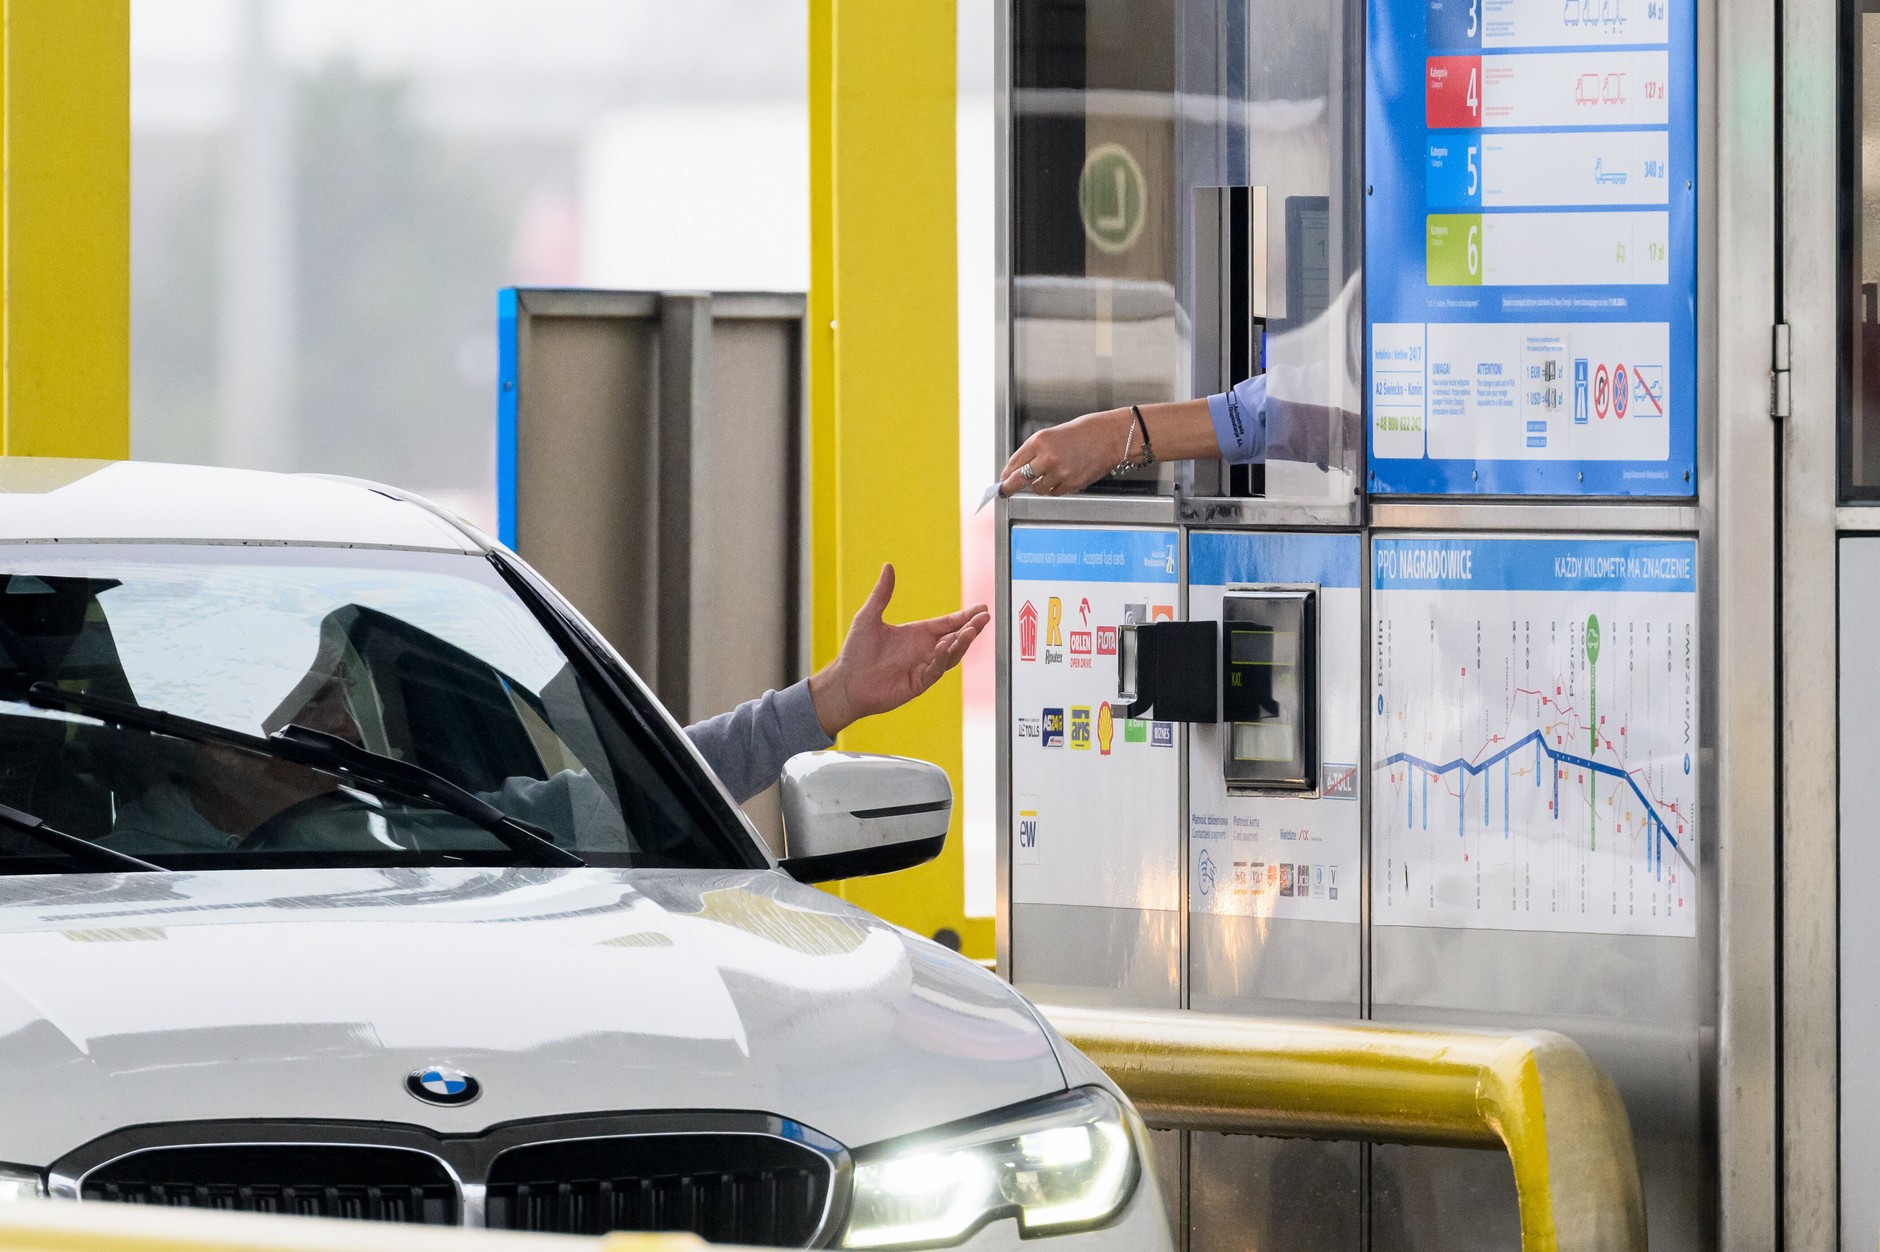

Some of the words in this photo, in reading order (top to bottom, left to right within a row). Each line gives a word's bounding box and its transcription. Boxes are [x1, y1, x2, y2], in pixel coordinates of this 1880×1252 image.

[1467, 0, 1478, 37] 3
[1648, 2, 1657, 19] 84
[1466, 67, 1478, 116] 4
[1644, 81, 1656, 99] 127
[1467, 146, 1478, 196] 5
[1644, 160, 1657, 178] 340
[1467, 225, 1478, 275] 6
[1649, 243, 1657, 260] 17
[1530, 366, 1541, 378] EUR
[1375, 382, 1383, 395] A2
[1383, 378, 1404, 396] Świecko
[1408, 382, 1422, 396] Konin
[1377, 549, 1397, 580] PPO
[1399, 549, 1473, 580] NAGRADOWICE
[1554, 552, 1583, 578] KAŻDY
[1584, 557, 1626, 578] KILOMETR
[1627, 557, 1640, 578] MA
[1642, 557, 1691, 580] ZNACZENIE
[1045, 596, 1063, 647] R
[1071, 634, 1091, 651] ORLEN
[1097, 631, 1116, 651] FLOTA
[1044, 649, 1064, 665] Routex
[1327, 773, 1353, 792] e-TOLL
